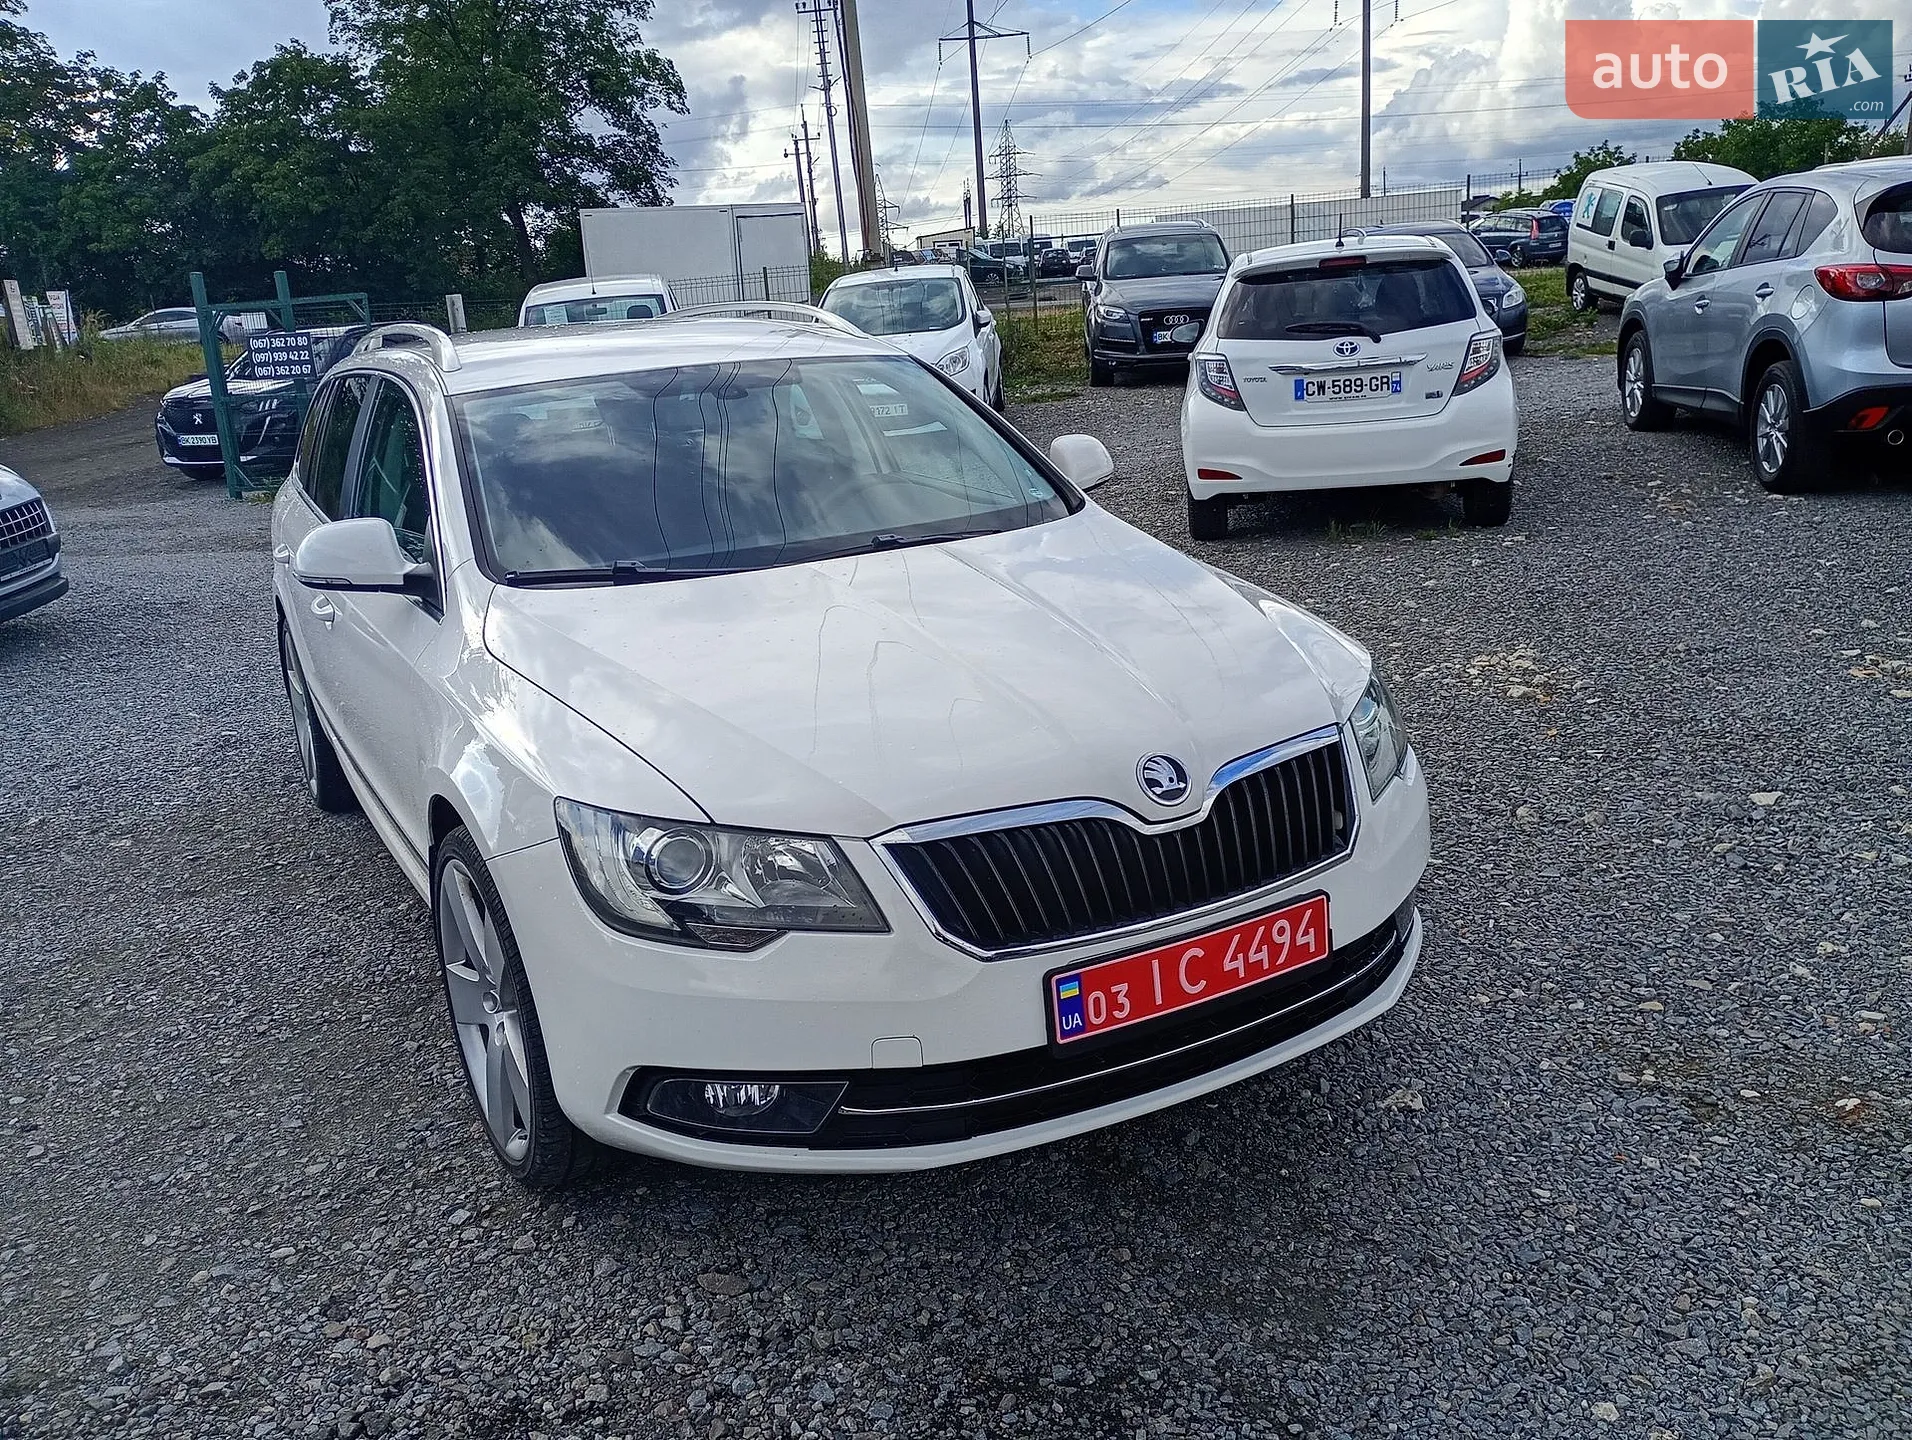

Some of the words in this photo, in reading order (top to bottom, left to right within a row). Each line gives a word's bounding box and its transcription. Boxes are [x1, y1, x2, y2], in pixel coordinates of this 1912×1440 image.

[249, 337, 270, 350] (067)
[270, 337, 286, 348] 362
[286, 336, 296, 347] 70
[297, 336, 308, 346] 80
[252, 350, 272, 364] (097)
[273, 351, 288, 362] 939
[289, 350, 299, 361] 42
[299, 350, 310, 360] 22
[254, 364, 275, 378] (067)
[275, 365, 290, 376] 362
[290, 365, 301, 375] 20
[302, 364, 312, 374] 67
[1305, 375, 1391, 397] CW-589-GR
[1392, 383, 1401, 392] 74
[1087, 982, 1131, 1025] 03
[1223, 908, 1316, 979] 4494
[1062, 1014, 1083, 1030] UA
